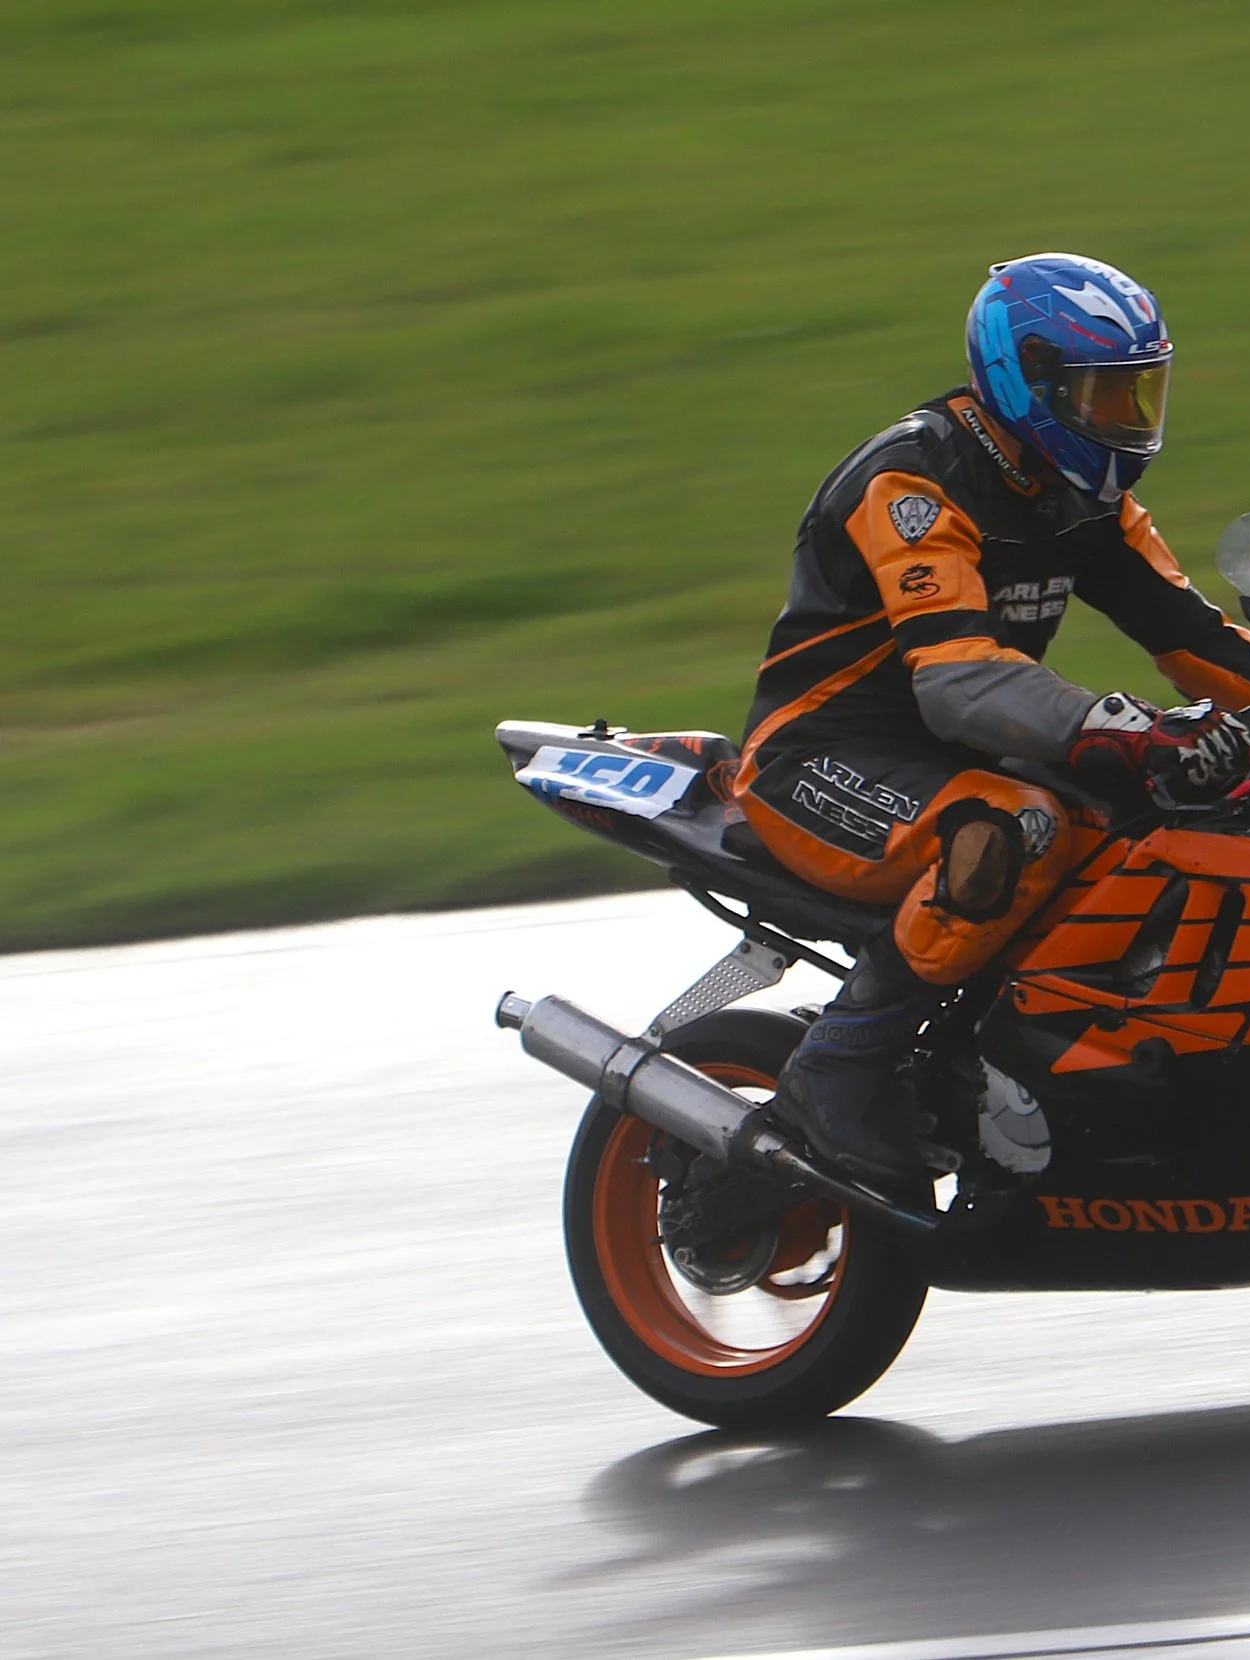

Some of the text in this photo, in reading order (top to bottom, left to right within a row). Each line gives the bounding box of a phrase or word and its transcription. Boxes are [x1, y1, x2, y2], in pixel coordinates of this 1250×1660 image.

[1128, 339, 1168, 354] LS2
[960, 407, 998, 455] ARLEN
[991, 576, 1076, 602] ARLEN
[1000, 600, 1065, 622] NESS
[801, 756, 921, 822] ARLEN
[791, 780, 890, 845] NESS
